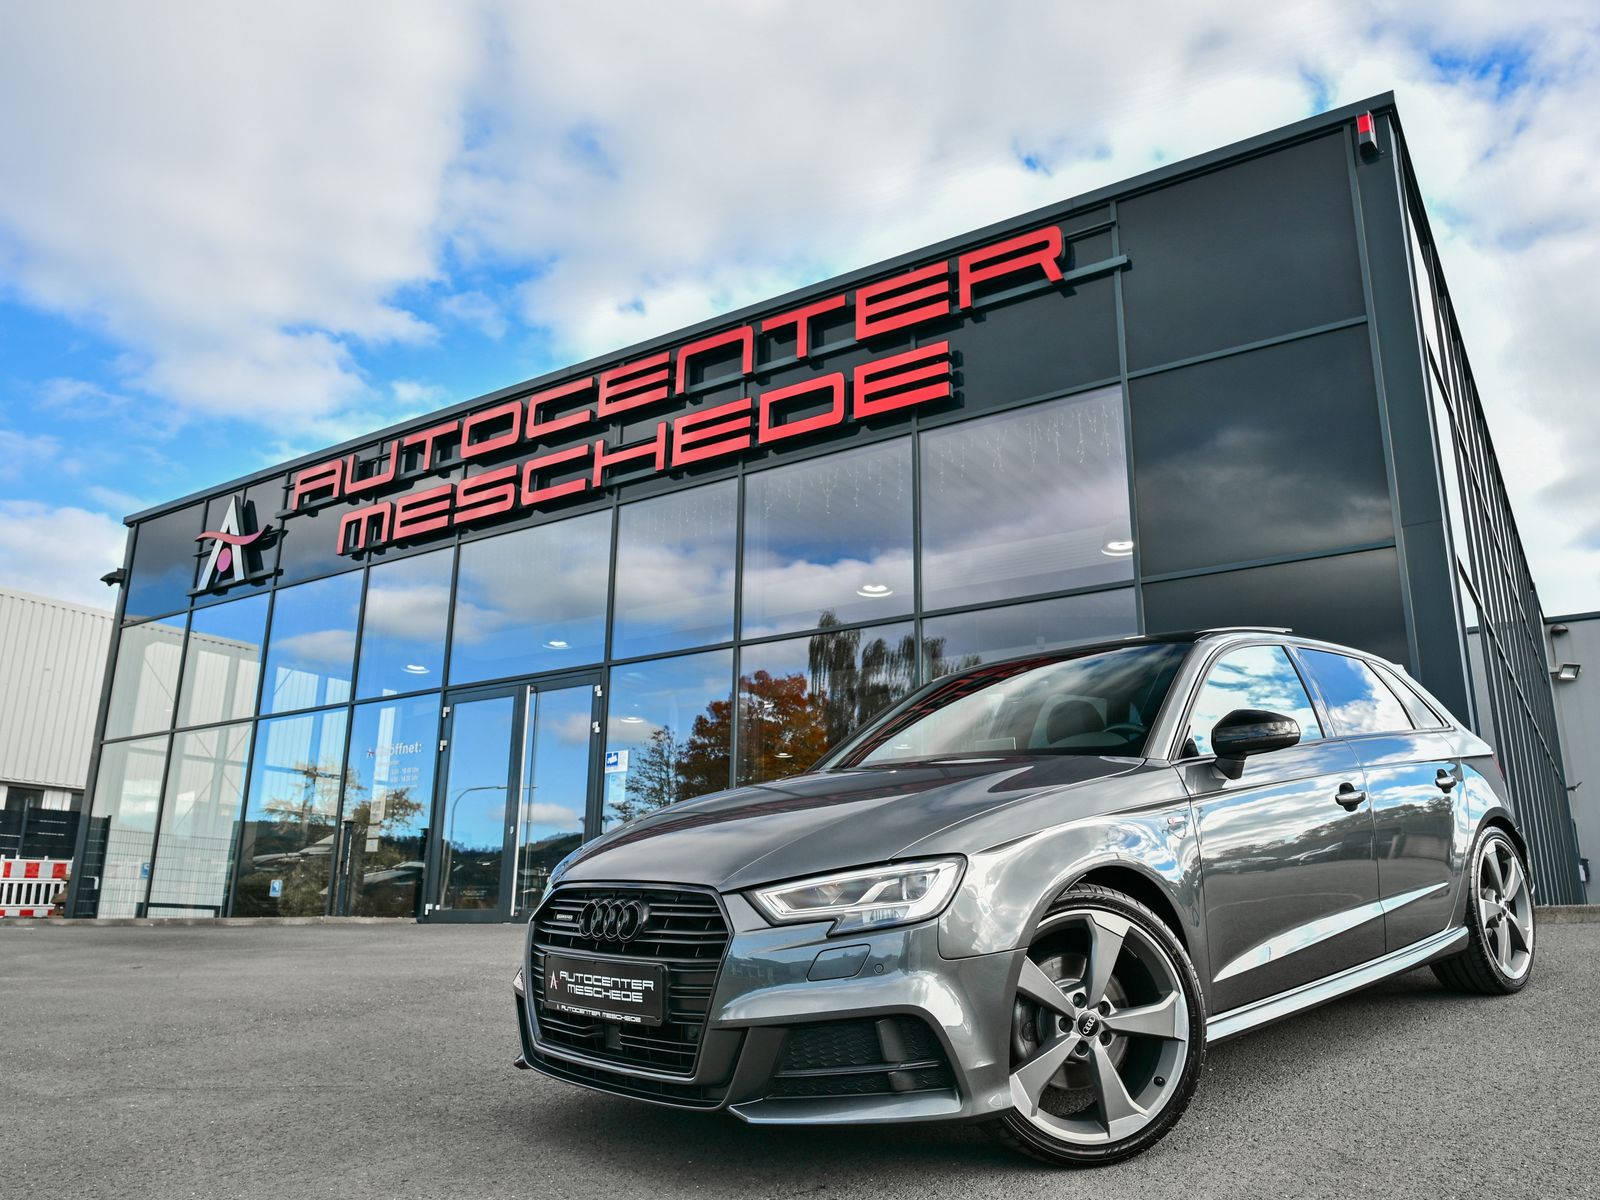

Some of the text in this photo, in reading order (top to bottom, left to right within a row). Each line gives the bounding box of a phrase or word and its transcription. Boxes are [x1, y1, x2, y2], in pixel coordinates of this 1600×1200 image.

[291, 225, 1065, 512] AUTOCENTER
[337, 340, 953, 556] MESCHEDE
[559, 970, 654, 991] AUTOCENTER
[567, 983, 643, 1003] MESCHEDE
[561, 1004, 600, 1017] AUTOCENTER
